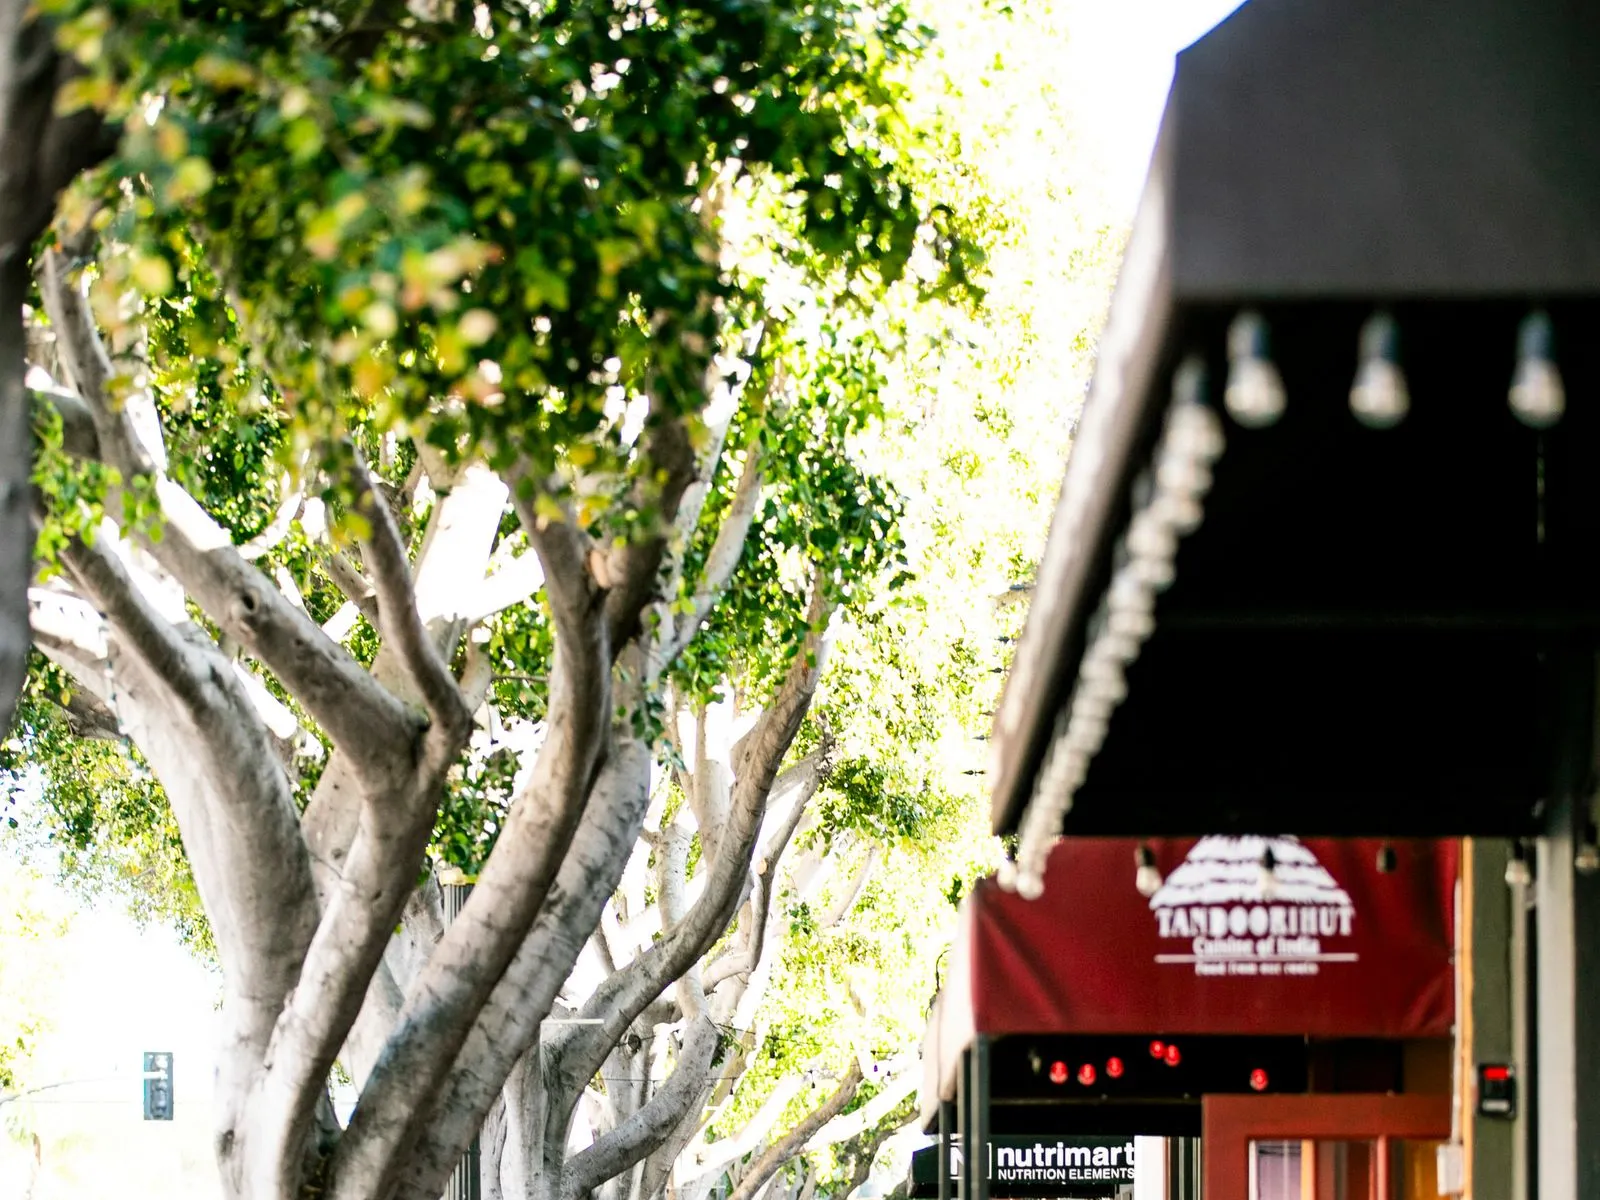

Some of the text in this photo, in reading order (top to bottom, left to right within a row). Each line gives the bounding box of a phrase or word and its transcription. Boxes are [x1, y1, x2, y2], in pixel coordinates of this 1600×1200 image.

[1256, 935, 1275, 958] of
[1277, 936, 1319, 956] India
[997, 1142, 1135, 1167] nutrimart
[998, 1168, 1135, 1180] NUTRITION ELEMENTS
